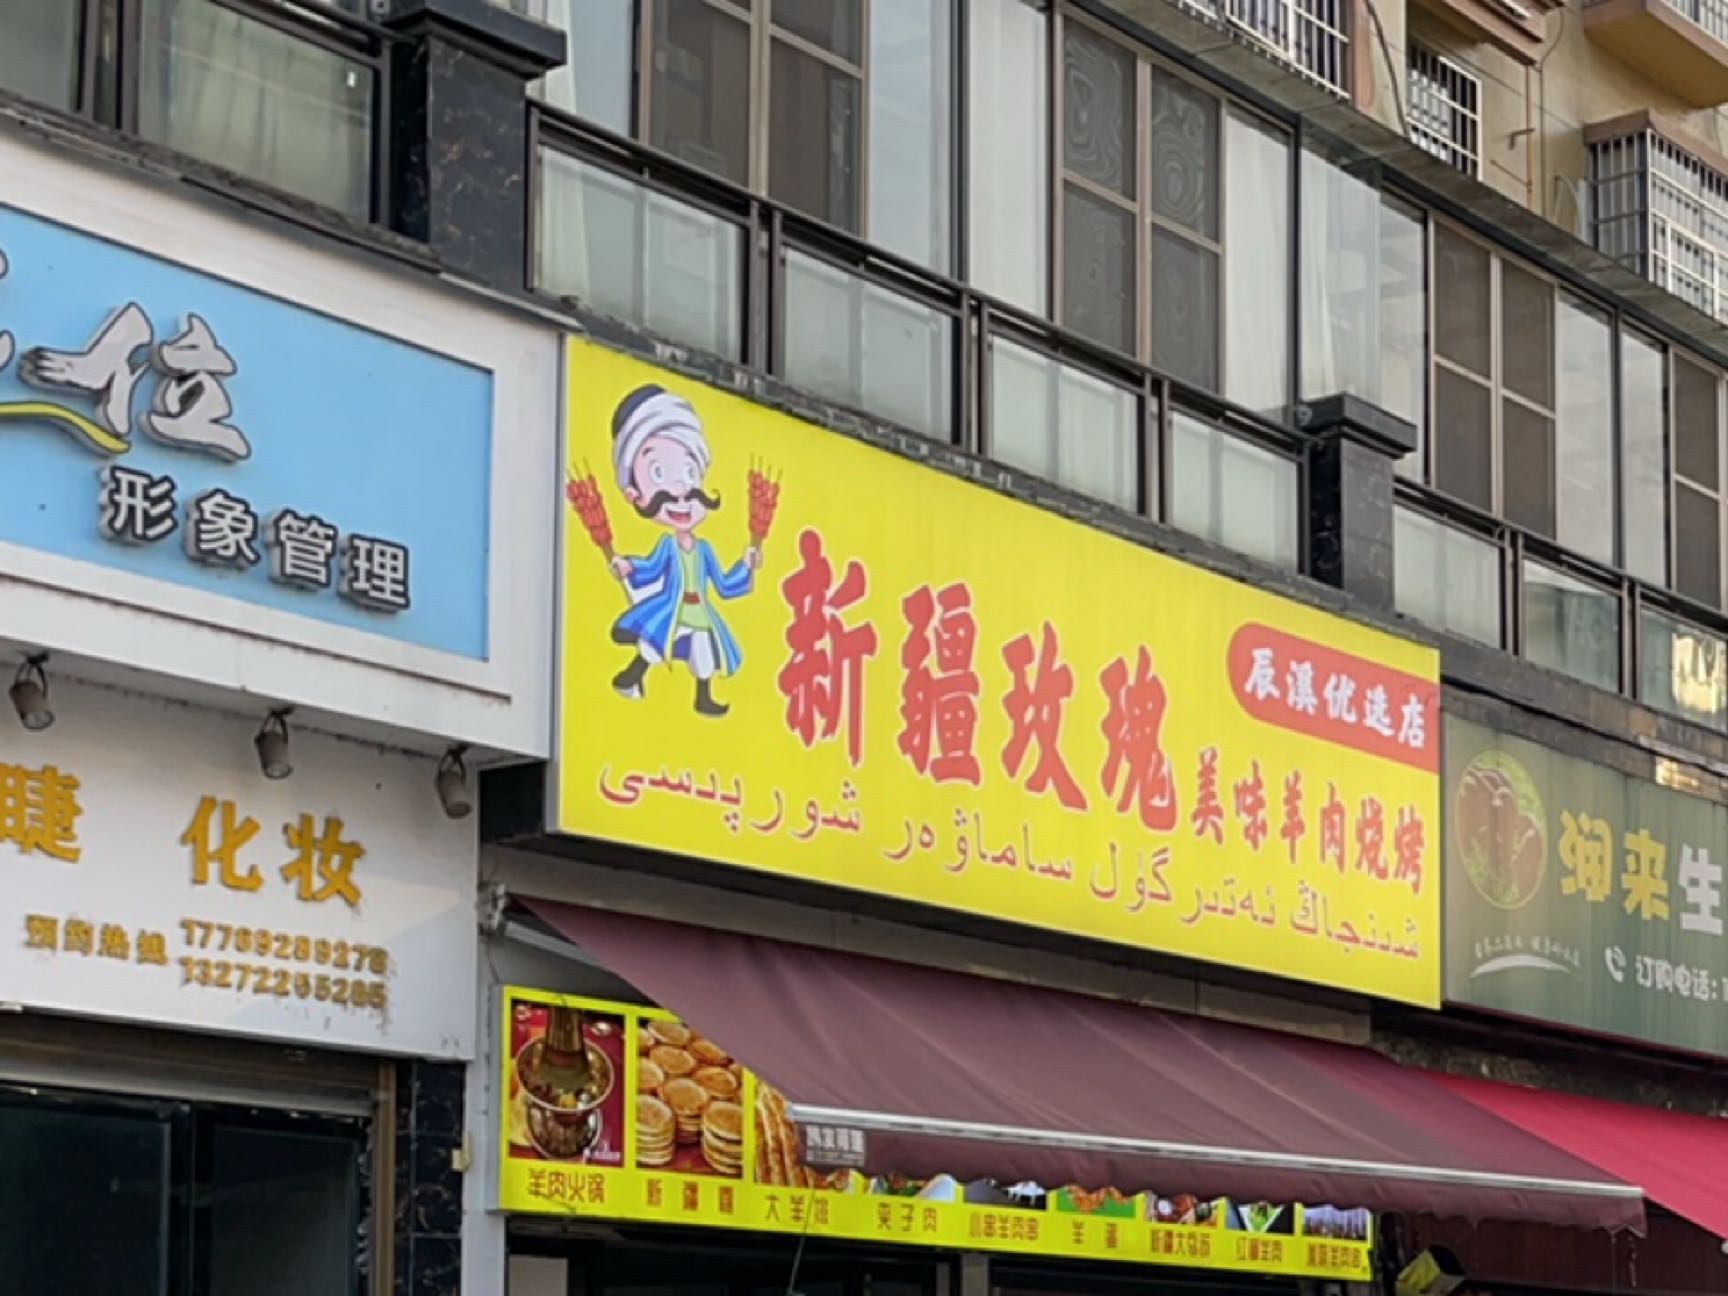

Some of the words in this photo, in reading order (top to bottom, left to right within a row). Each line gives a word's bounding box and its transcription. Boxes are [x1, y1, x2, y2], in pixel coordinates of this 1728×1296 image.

[0, 247, 252, 462] 位
[98, 464, 412, 614] 形象管理
[777, 525, 1180, 832] 新疆玫瑰
[1244, 647, 1425, 748] 辰溪优选店
[180, 794, 367, 908] 化妆
[1191, 746, 1425, 895] 美味羊肉烧烤
[527, 1167, 605, 1204] 羊肉火锅
